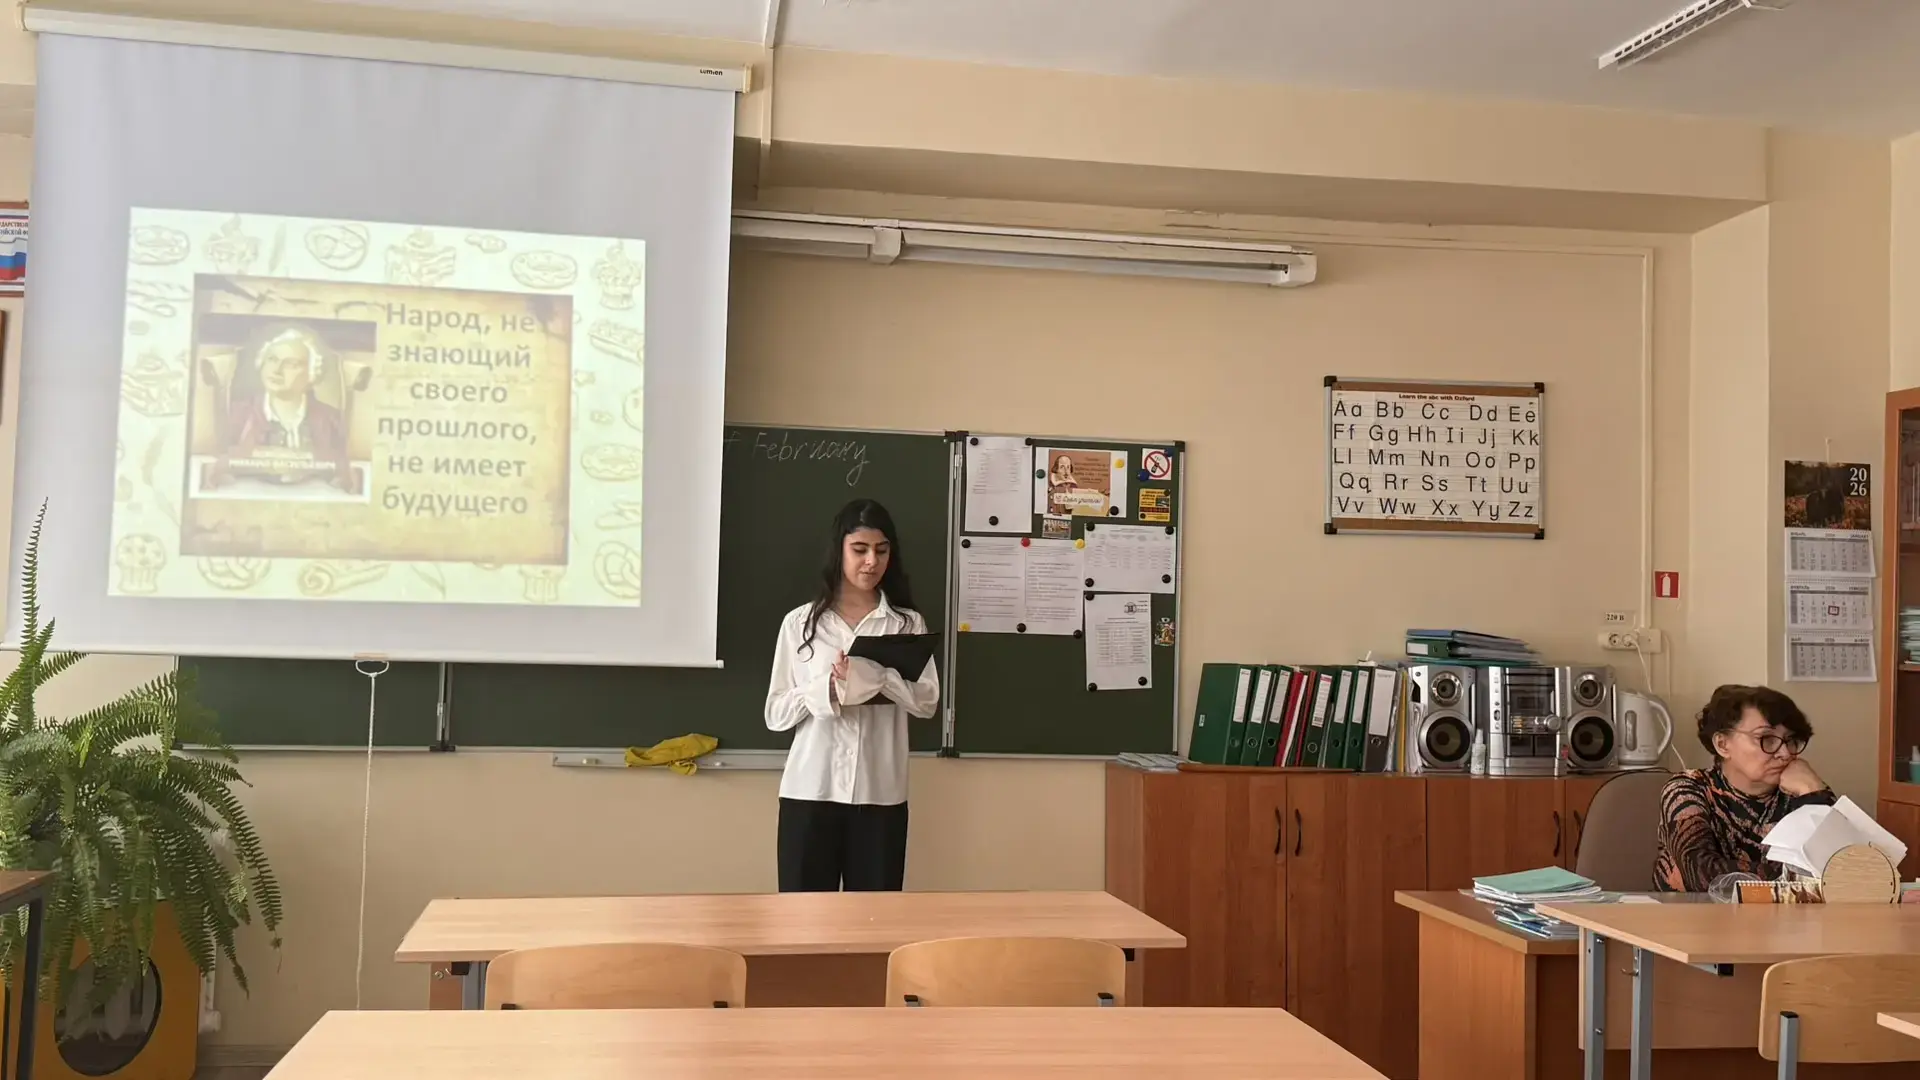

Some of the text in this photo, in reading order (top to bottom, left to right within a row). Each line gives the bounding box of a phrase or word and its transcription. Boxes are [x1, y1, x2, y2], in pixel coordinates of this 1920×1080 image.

[386, 302, 535, 335] Народ, не
[387, 343, 531, 371] знающий
[410, 382, 508, 403] своего
[378, 416, 537, 446] прошлого,
[388, 455, 527, 477] не имеет
[752, 431, 870, 486] February
[1850, 467, 1867, 482] 20
[382, 485, 528, 517] будущего
[1850, 482, 1867, 496] 26
